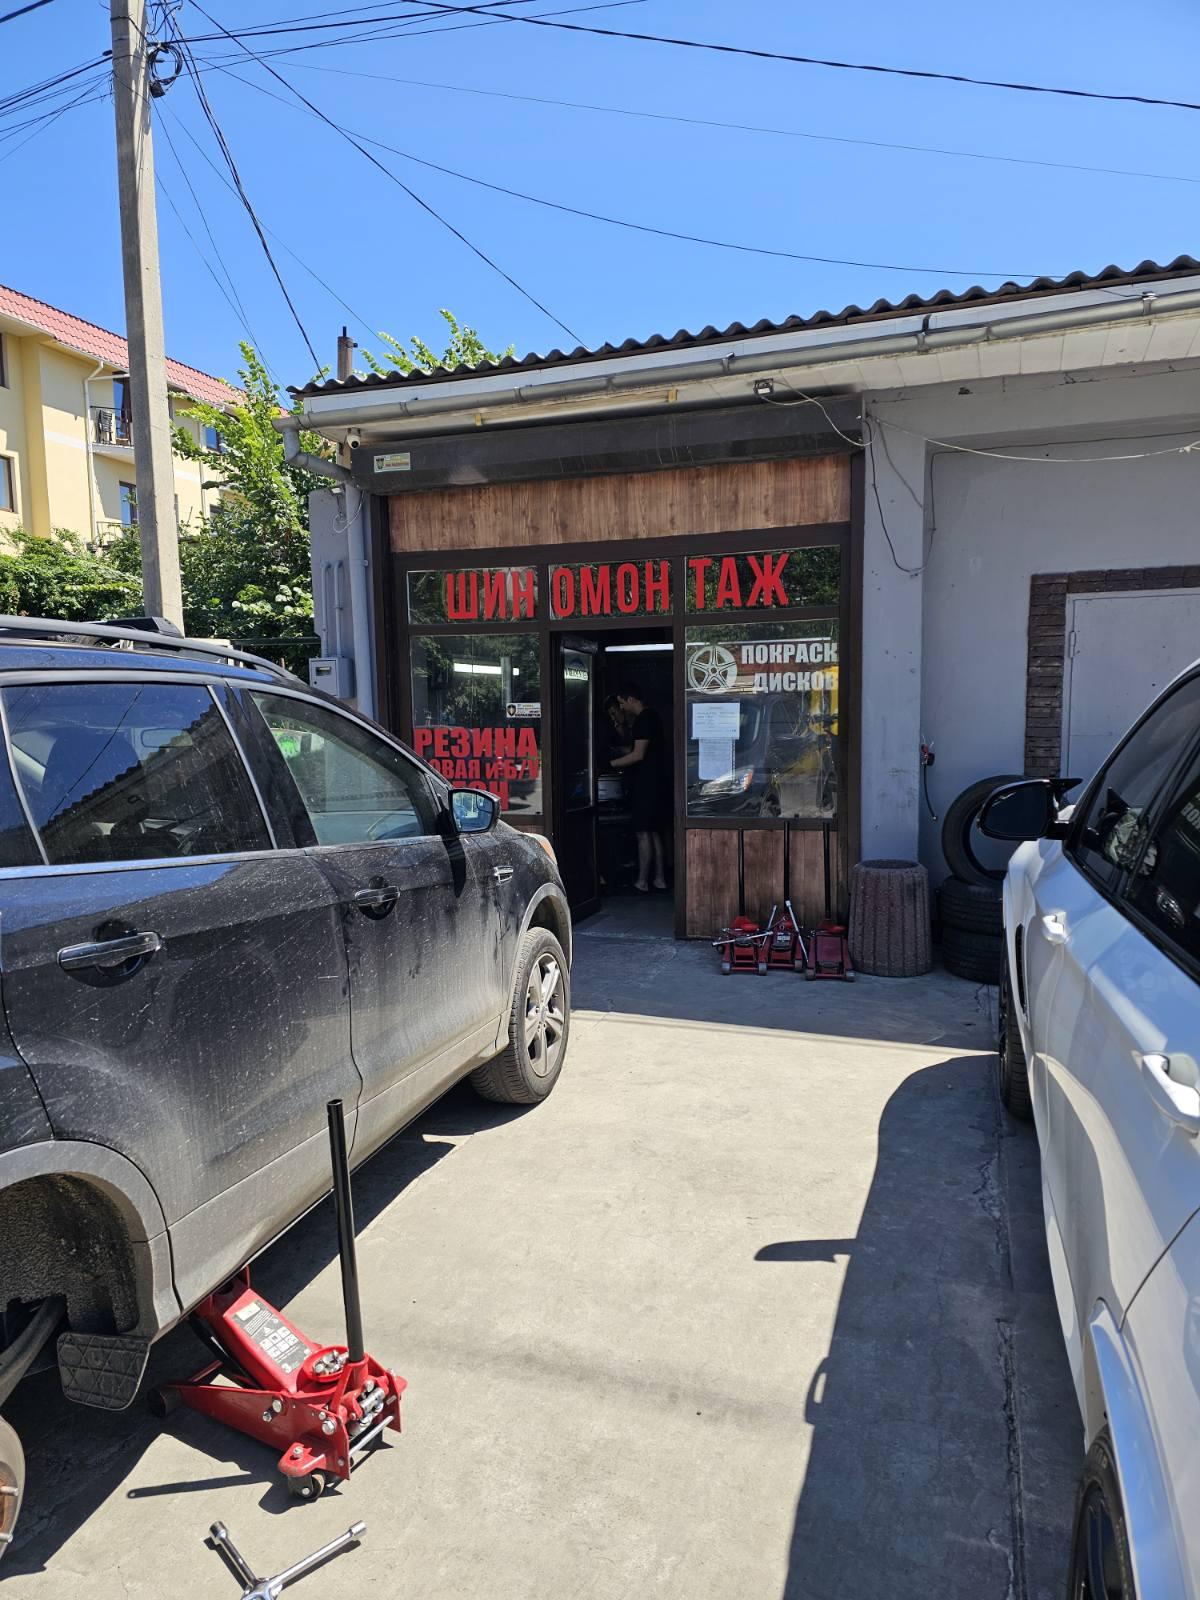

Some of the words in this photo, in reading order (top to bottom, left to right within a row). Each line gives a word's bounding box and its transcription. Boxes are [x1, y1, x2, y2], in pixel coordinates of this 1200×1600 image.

[741, 642, 839, 664] ПОКРАСК
[752, 670, 839, 693] ДИСКОВ
[414, 727, 538, 758] РЕЗИНА
[428, 758, 480, 779] ВАЯ
